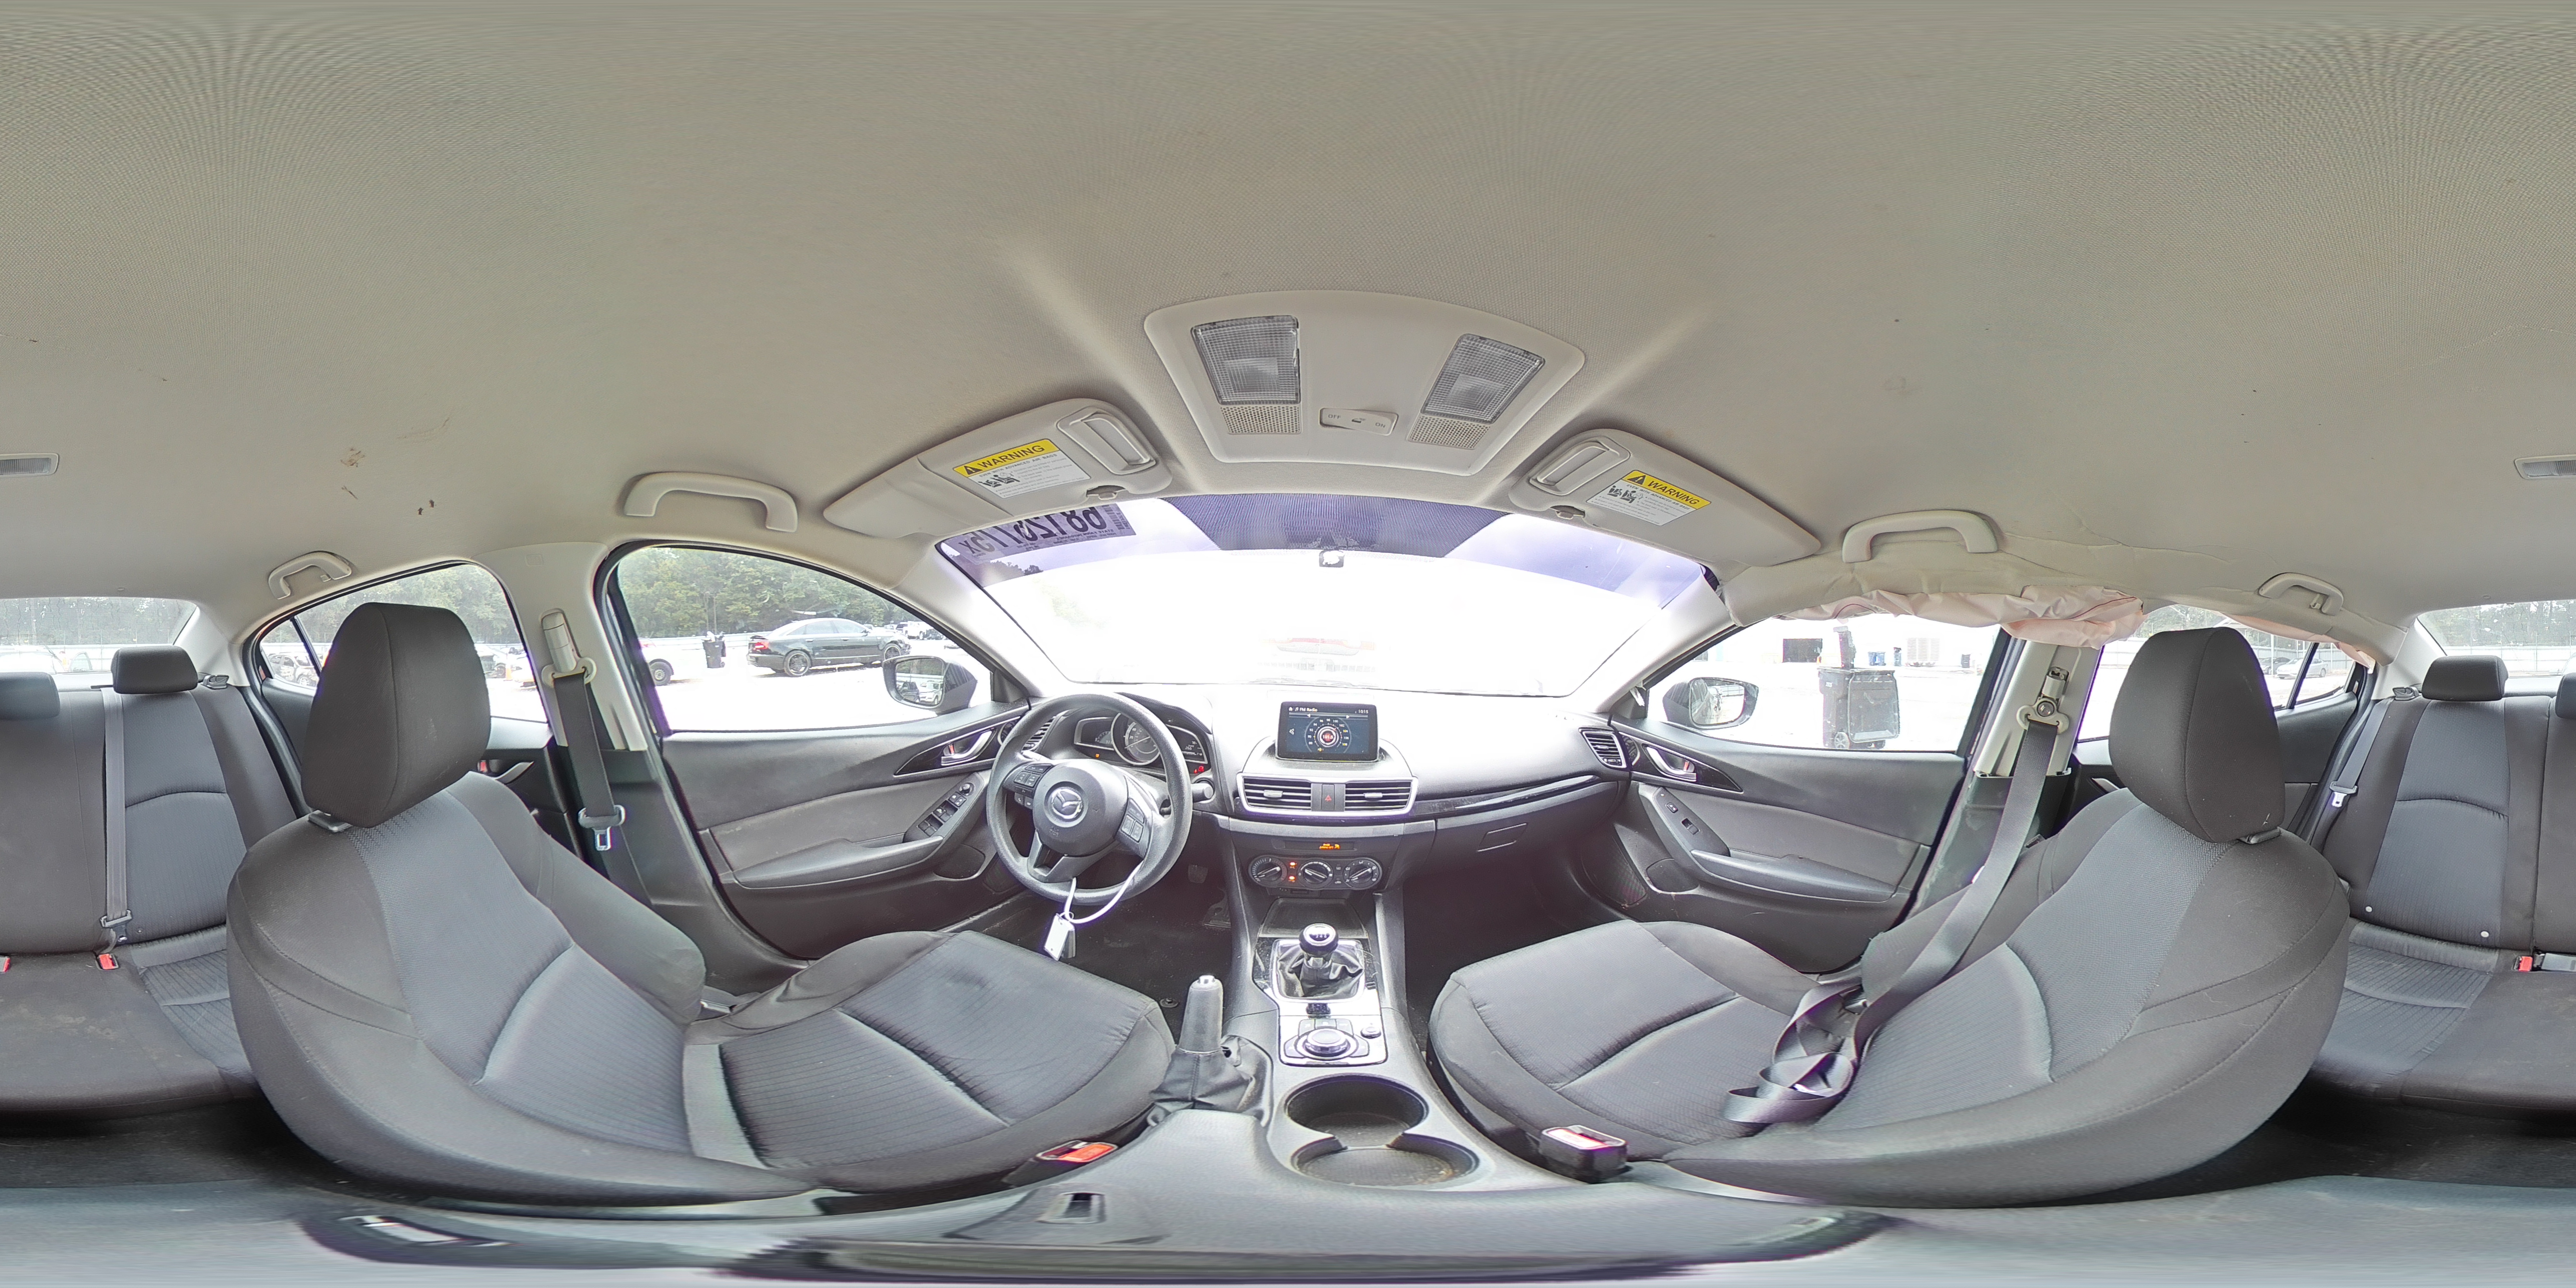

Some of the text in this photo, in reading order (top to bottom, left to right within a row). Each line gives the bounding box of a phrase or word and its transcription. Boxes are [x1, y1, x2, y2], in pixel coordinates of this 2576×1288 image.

[978, 445, 1045, 468] WARNING
[1005, 460, 1030, 470] ADVANCED
[1647, 481, 1700, 505] WARNING
[1650, 493, 1672, 502] ADVANCED
